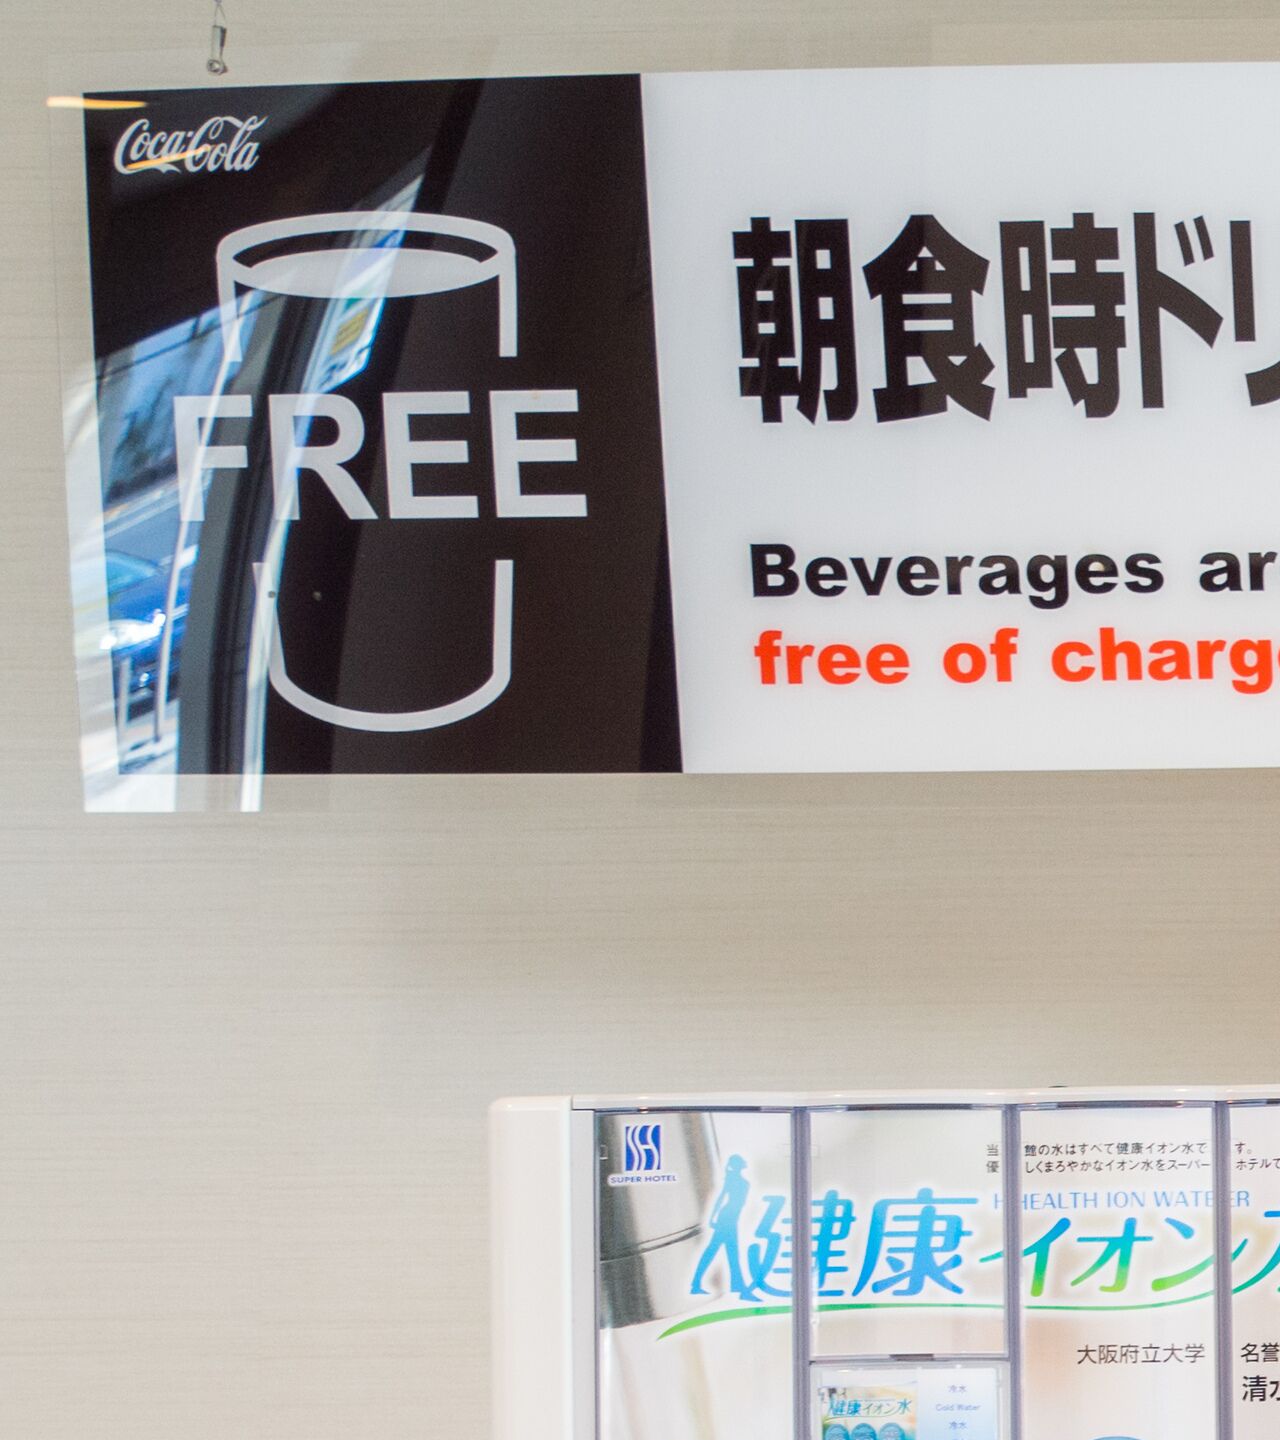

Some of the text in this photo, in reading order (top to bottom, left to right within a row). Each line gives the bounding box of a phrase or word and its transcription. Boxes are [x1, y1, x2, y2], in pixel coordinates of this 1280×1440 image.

[113, 115, 267, 175] Coca-Cola
[172, 388, 589, 523] FREE
[750, 542, 1165, 609] Beverages
[754, 630, 910, 686] free
[942, 628, 1018, 683] of
[610, 1174, 677, 1184] SUPER HOTEL
[1106, 1191, 1145, 1208] ION
[1077, 1344, 1206, 1365] 大阪府立大学
